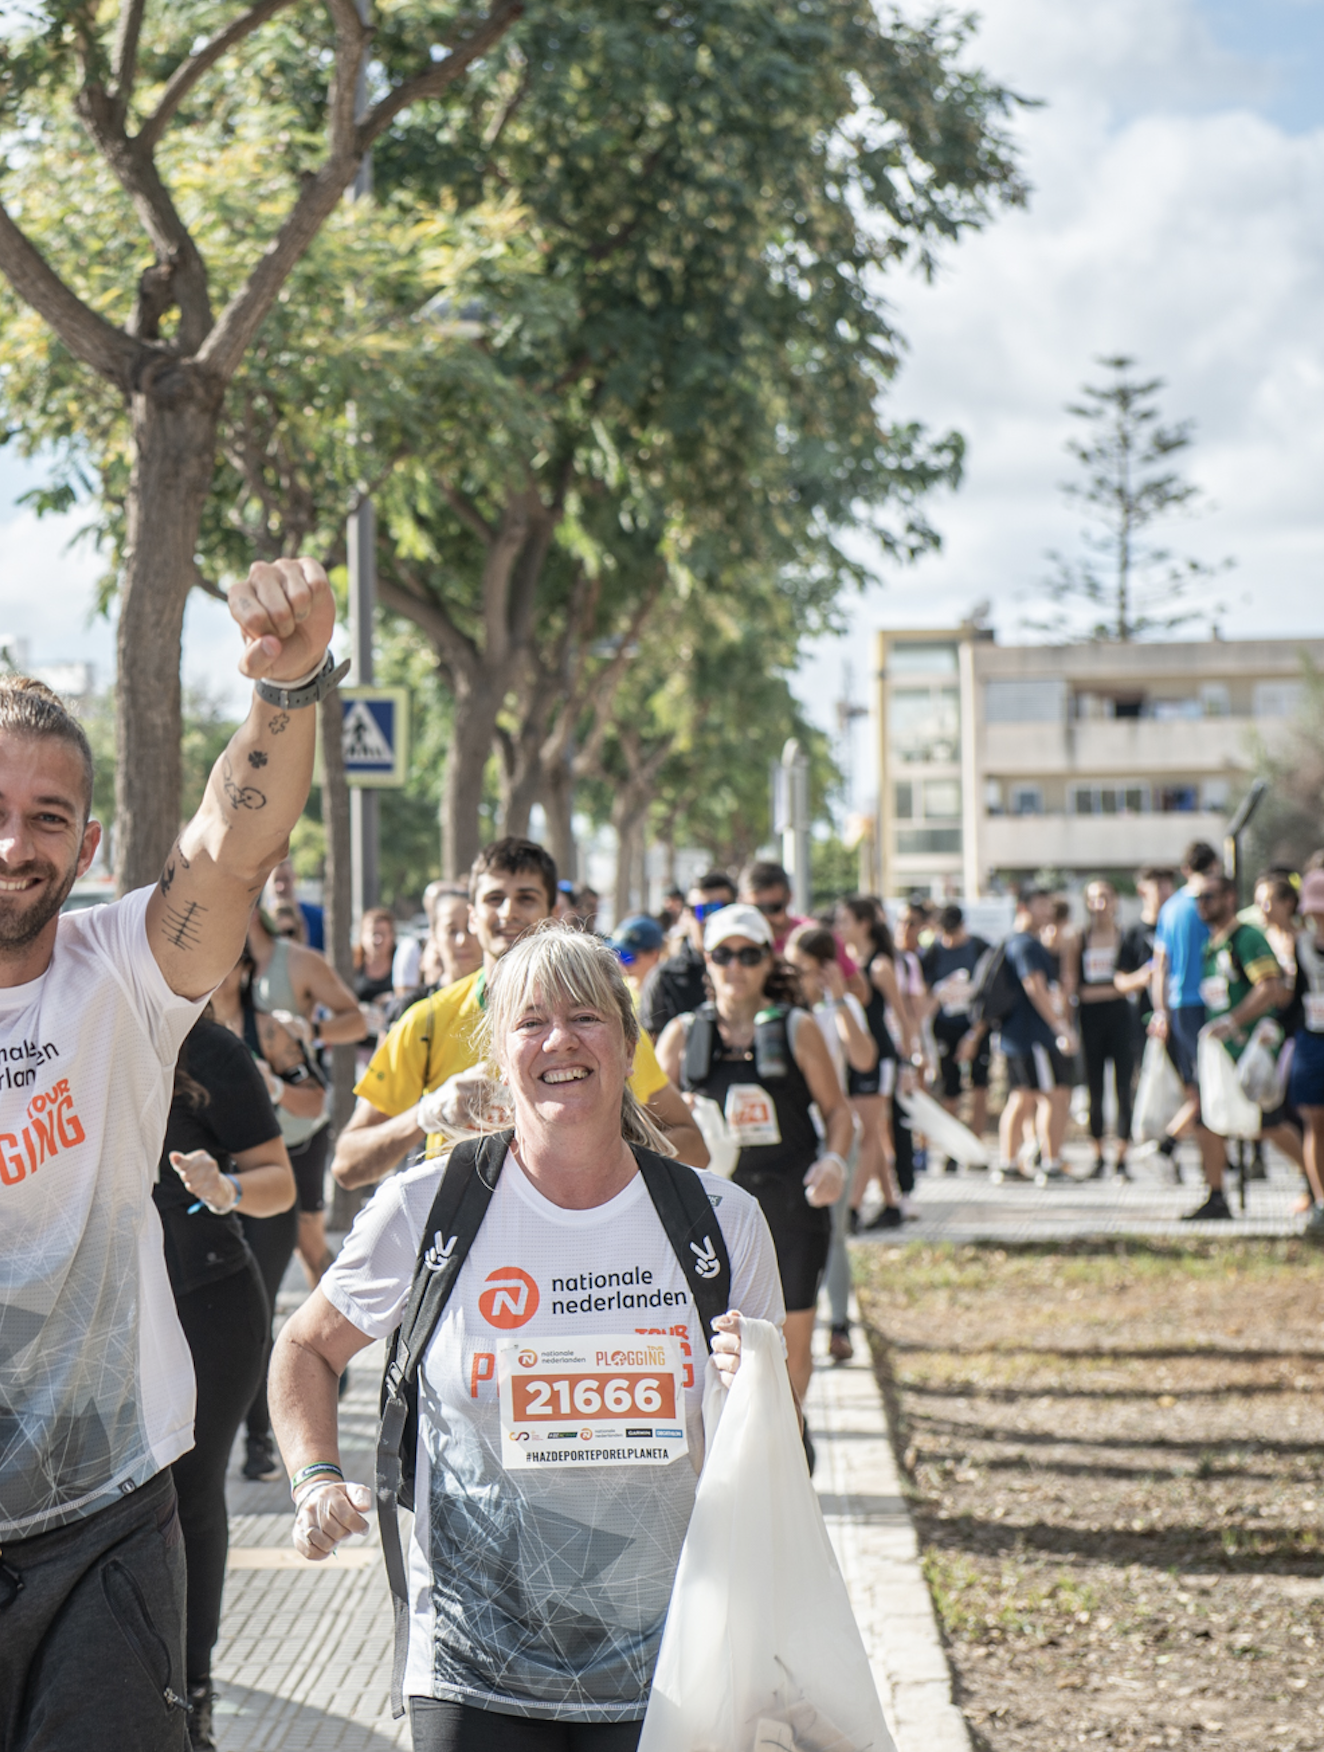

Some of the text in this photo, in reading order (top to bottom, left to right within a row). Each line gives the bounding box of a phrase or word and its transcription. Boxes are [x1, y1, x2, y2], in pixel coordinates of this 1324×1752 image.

[552, 1266, 653, 1292] nationale
[552, 1289, 687, 1315] nederlanden
[541, 1356, 587, 1364] nederlanden
[525, 1378, 662, 1415] 21666
[526, 1448, 669, 1463] #HAZDEPORTEPORELPLANETA
